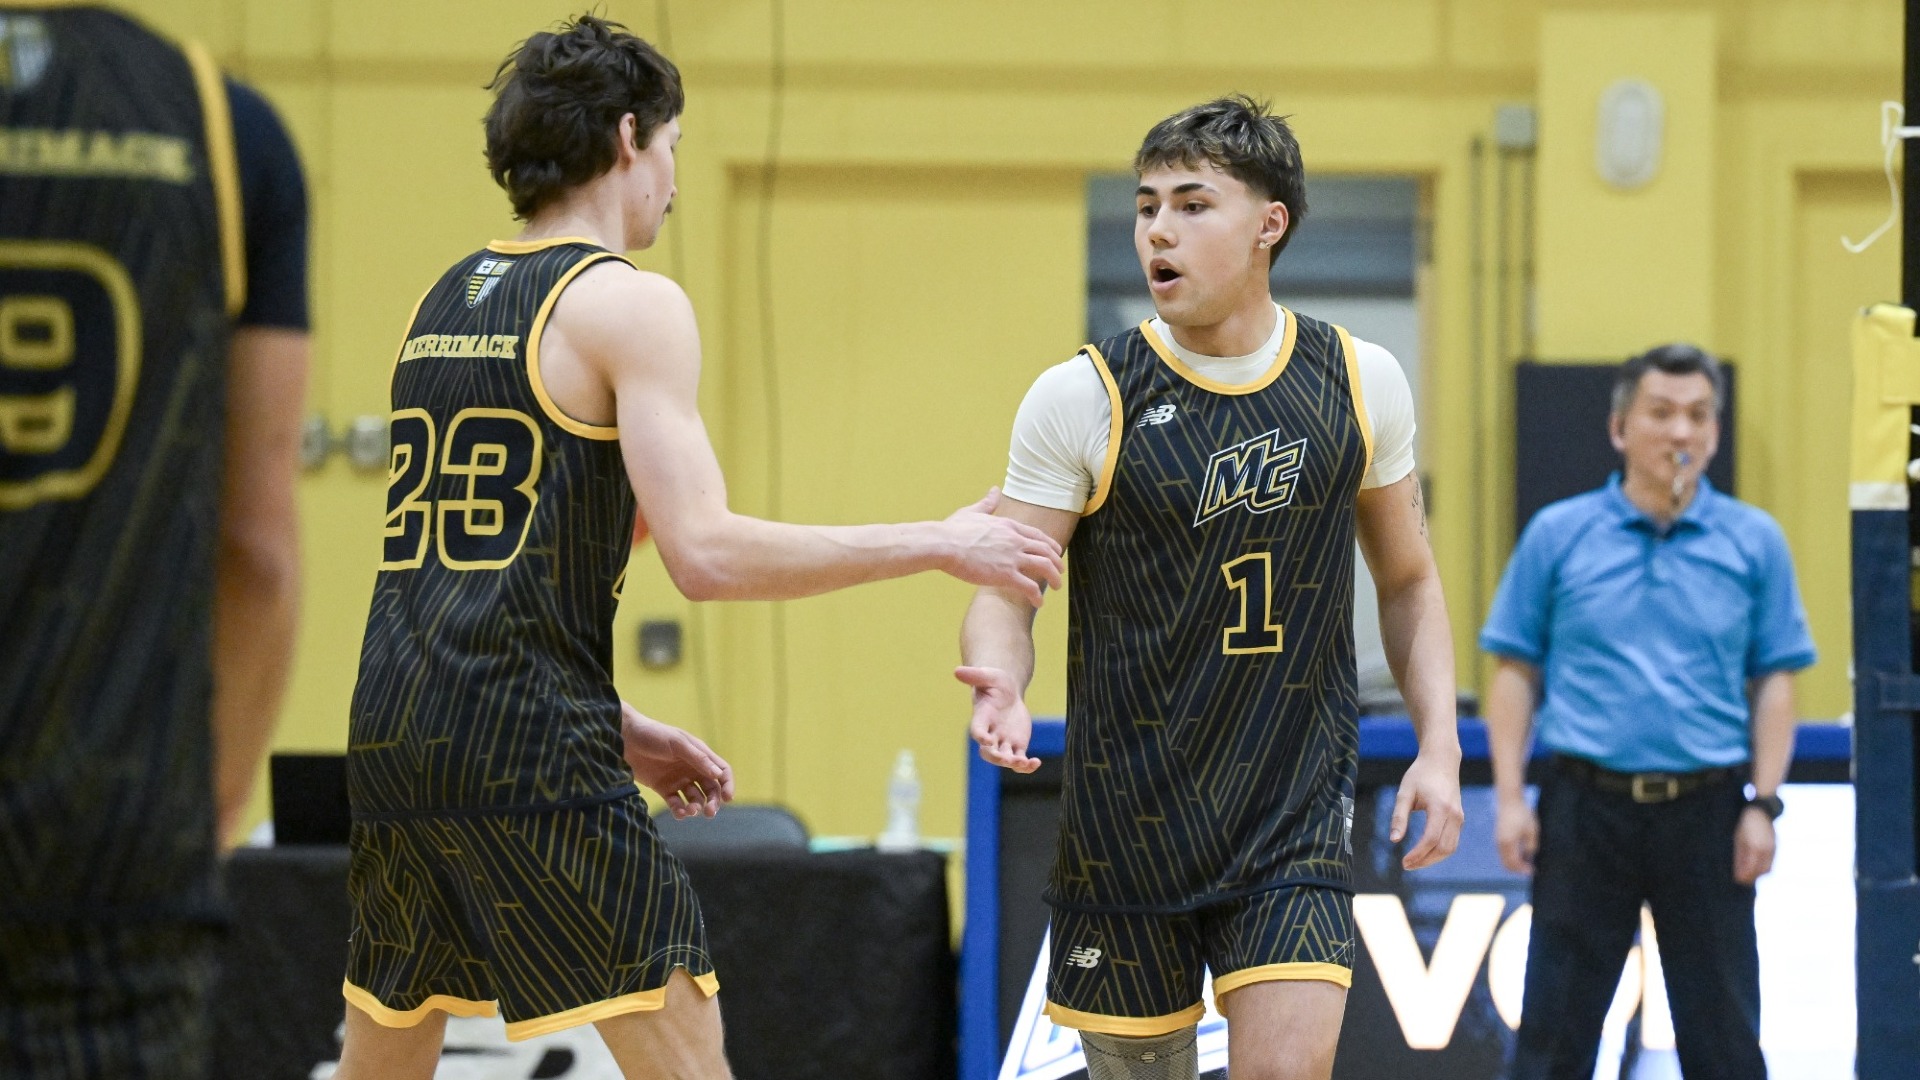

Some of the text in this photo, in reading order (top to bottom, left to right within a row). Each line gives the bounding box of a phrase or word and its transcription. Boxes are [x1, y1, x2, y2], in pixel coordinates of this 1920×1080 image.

[378, 407, 544, 571] 23
[1194, 428, 1307, 528] MC
[1221, 551, 1283, 655] 1
